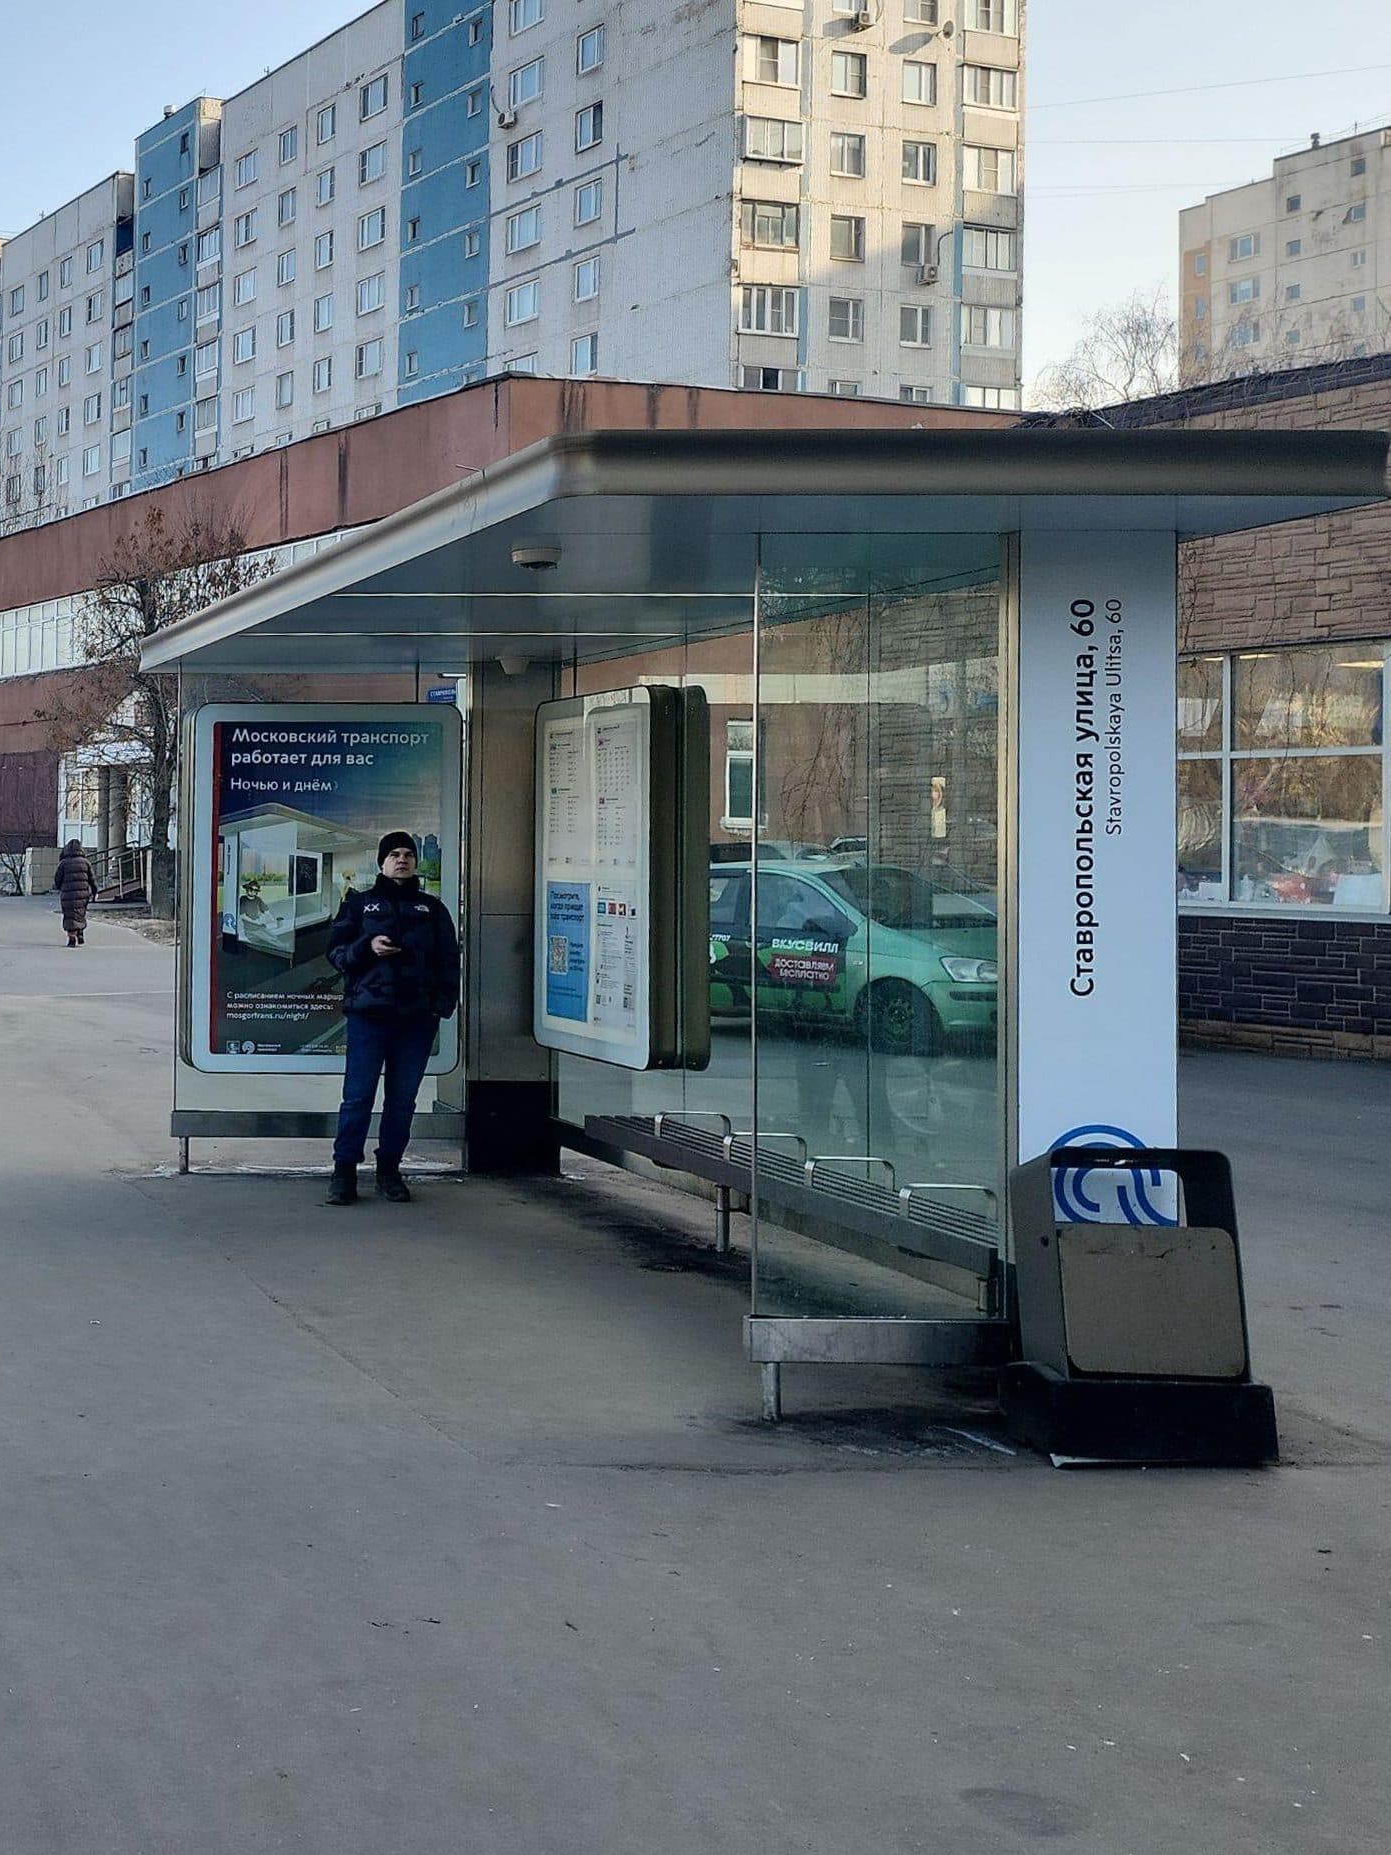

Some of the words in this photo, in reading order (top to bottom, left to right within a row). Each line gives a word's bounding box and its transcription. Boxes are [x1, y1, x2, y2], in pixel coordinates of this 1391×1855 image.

[1070, 599, 1095, 637] 60
[1105, 599, 1122, 624] 60
[1105, 628, 1124, 686] Ulitsa,
[1074, 644, 1100, 743] улица,
[231, 728, 337, 744] Московский
[341, 731, 430, 747] транспорт
[230, 751, 307, 766] работает
[311, 753, 341, 766] для
[346, 753, 374, 765] вас
[1105, 692, 1126, 835] Stavropolskaya
[230, 778, 279, 791] Ночью
[282, 782, 291, 791] и
[294, 779, 333, 792] днём
[1069, 753, 1100, 997] Ставропольская
[771, 938, 839, 953] ВКУСВИЛЛ
[774, 958, 835, 972] ДОСТАВЛЯЕМ
[779, 968, 829, 981] БЕСПЛАТНО
[226, 991, 233, 999] С
